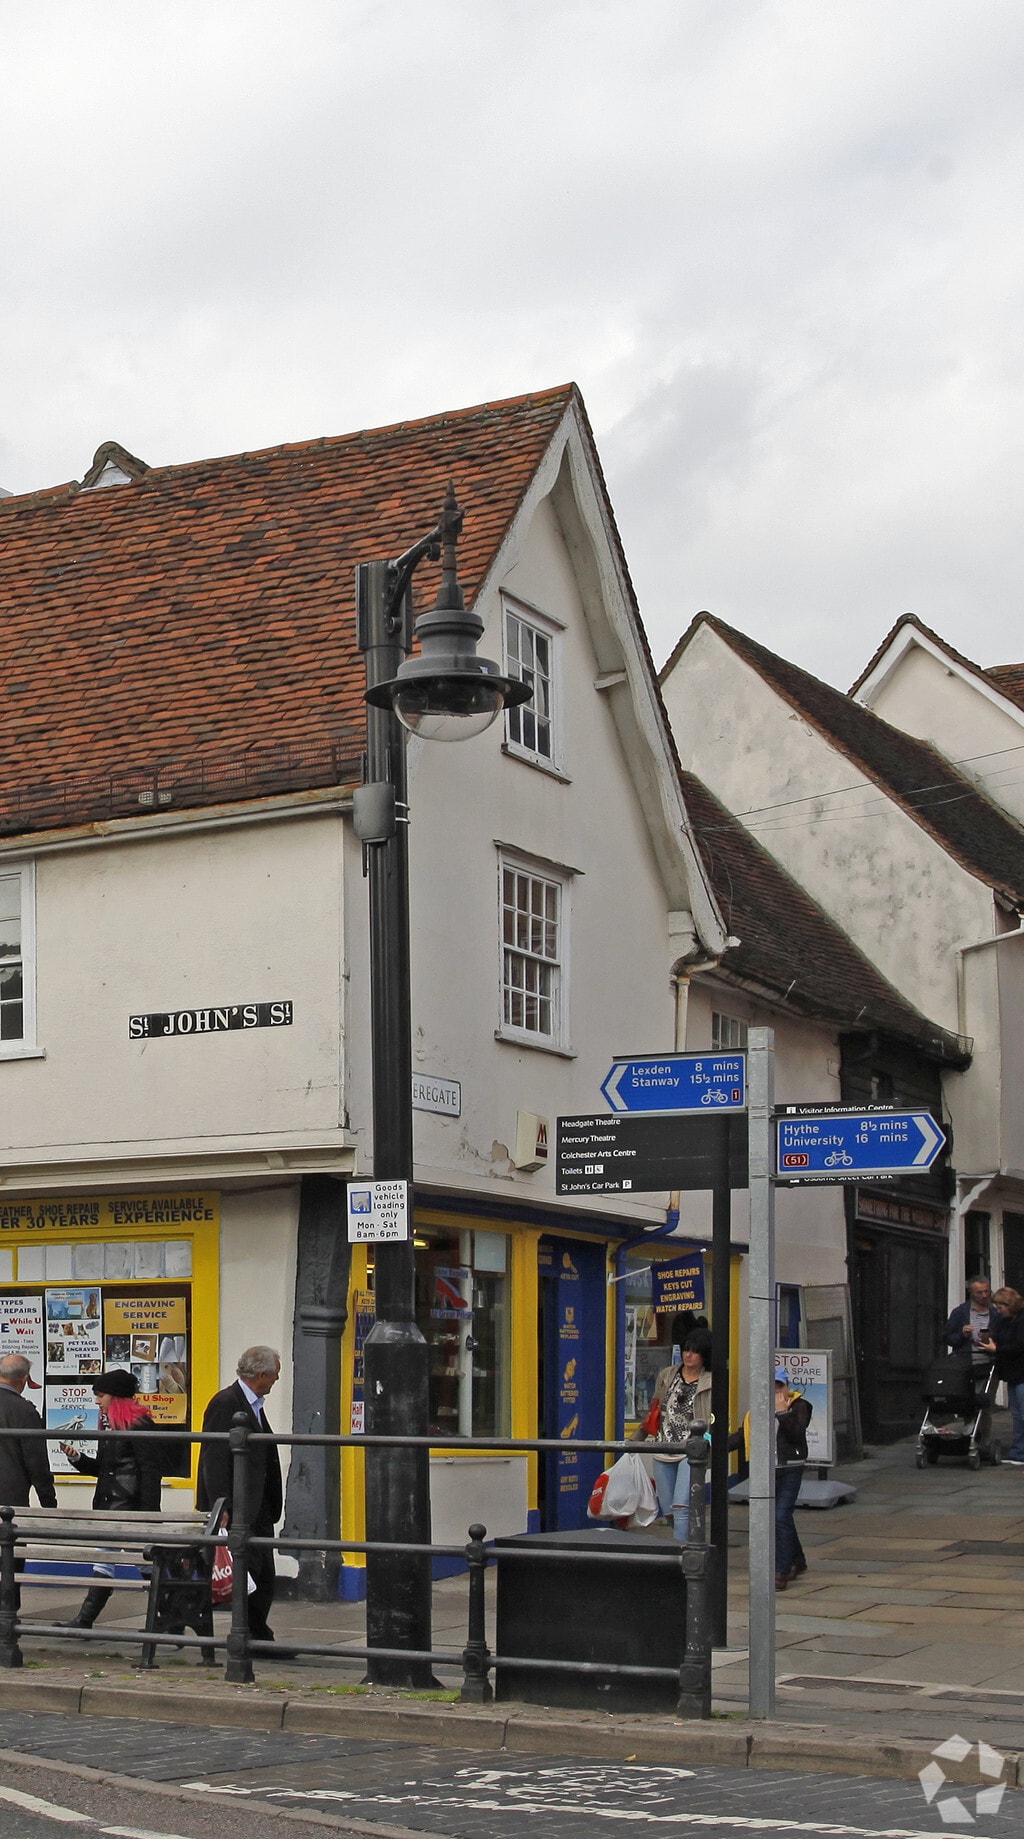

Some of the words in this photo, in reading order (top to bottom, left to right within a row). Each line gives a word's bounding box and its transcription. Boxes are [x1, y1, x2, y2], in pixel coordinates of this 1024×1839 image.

[163, 1006, 257, 1035] JOHN'S
[632, 1065, 671, 1076] Lexden
[695, 1062, 703, 1072] 8
[713, 1061, 739, 1071] mins
[632, 1077, 680, 1088] Stanway
[713, 1073, 739, 1083] mins
[561, 1120, 594, 1128] Headgate
[595, 1118, 621, 1126] Theatre
[784, 1124, 820, 1136] Hythe
[880, 1120, 908, 1130] mins
[561, 1136, 589, 1144] Mercury
[590, 1134, 616, 1142] Theatre
[784, 1135, 844, 1147] University
[855, 1134, 869, 1144] 16
[880, 1132, 908, 1142] mins
[561, 1151, 597, 1159] Colchester
[597, 1150, 612, 1158] Arts
[613, 1149, 636, 1157] Centre
[561, 1167, 583, 1175] Toilets
[604, 1181, 620, 1189] Park
[374, 1192, 404, 1200] vehicle
[39, 1204, 64, 1216] SHOE
[67, 1202, 100, 1215] REPAIR
[108, 1200, 149, 1213] SERVICE
[151, 1197, 204, 1211] AVAILABLE
[373, 1202, 405, 1210] loading
[26, 1216, 45, 1229] 30
[49, 1214, 99, 1227] YEARS
[114, 1209, 214, 1224] EXPERIENCE
[380, 1211, 398, 1219] only
[356, 1230, 399, 1238] 8am-6pm
[657, 1271, 674, 1280] SHOE
[674, 1267, 700, 1277] REPAIRS
[663, 1282, 679, 1290] KEYS
[680, 1280, 693, 1289] CUT
[660, 1291, 695, 1303] ENGRAVING
[114, 1300, 176, 1308] ENGRAVING
[656, 1304, 677, 1313] WATCH
[677, 1302, 703, 1311] REPAIRS
[123, 1311, 168, 1319] SERVICE
[9, 1317, 33, 1325] While
[775, 1355, 810, 1367] STOP
[791, 1367, 821, 1376] SPARE
[792, 1376, 815, 1386] CUT
[62, 1388, 87, 1397] STOP
[152, 1394, 175, 1404] Shop
[352, 1418, 362, 1430] Key
